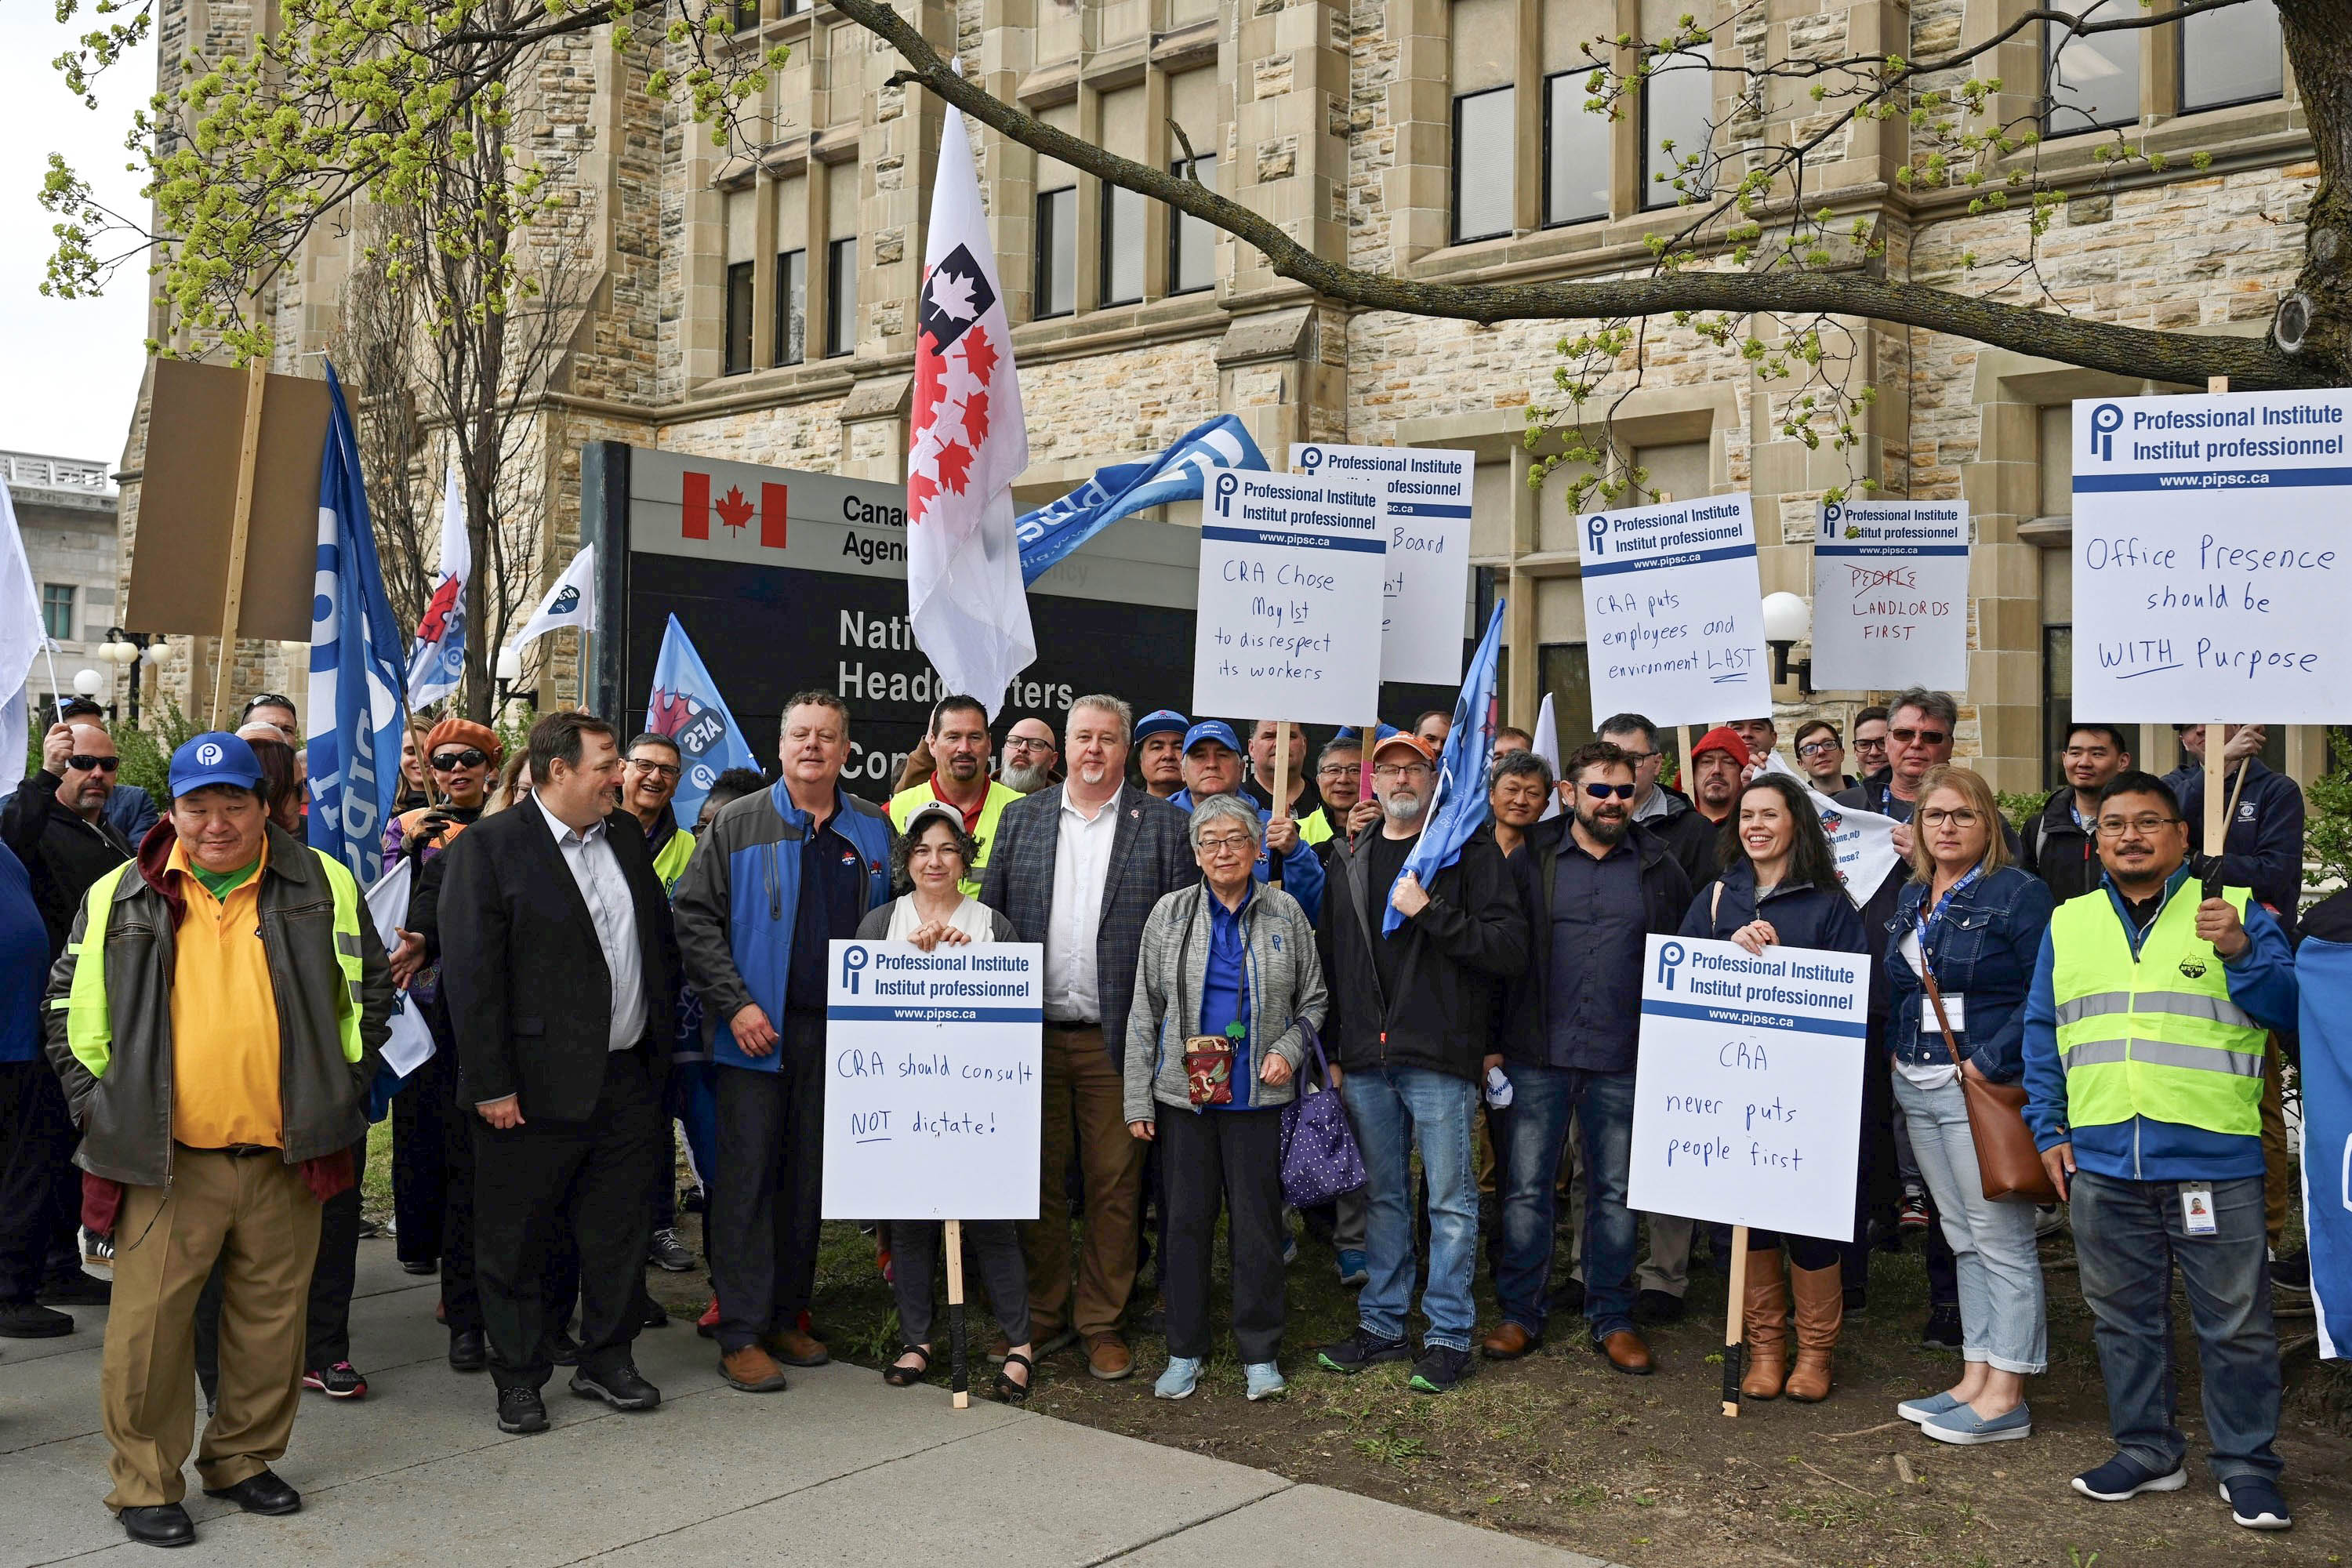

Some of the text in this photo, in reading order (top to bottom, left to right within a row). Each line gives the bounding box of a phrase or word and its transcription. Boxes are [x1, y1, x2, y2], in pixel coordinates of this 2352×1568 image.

[2133, 405, 2343, 430] Professional Institute
[2133, 435, 2343, 462] Institut professionnel
[1328, 455, 1462, 474] Professional Institute
[1387, 480, 1461, 496] ofessionnel
[2159, 473, 2270, 488] www.pipsc.ca
[1243, 482, 1376, 507] Professional Institute
[843, 495, 907, 527] Cana
[1243, 505, 1375, 530] Institut professionnel
[1613, 504, 1740, 532] Professional Institute
[1846, 510, 1958, 521] Professional Institute
[1259, 532, 1330, 546] www.pipsc.ca
[1392, 527, 1445, 554] Board
[1616, 523, 1743, 553] Institut professionnel
[1857, 527, 1958, 540] stitut professionnel
[842, 532, 907, 565] Agen
[1634, 554, 1701, 569] www.pipsc.ca
[1859, 547, 1918, 556] www.pipsc.ca
[2086, 535, 2336, 572] Office Presence
[1223, 560, 1335, 591] CRA Chose
[1596, 589, 1680, 618] CRA puts
[1853, 601, 1950, 616] LANDLORDS
[2147, 582, 2270, 613] should be
[1252, 597, 1309, 628] May 1st
[1214, 627, 1332, 658] to disrespect
[1602, 615, 1735, 651] employees and
[1864, 625, 1916, 641] FIRST
[1219, 659, 1323, 681] its workers
[1609, 648, 1756, 679] environment LAST
[2099, 637, 2318, 679] WITH Purpose
[1839, 851, 1860, 863] lose?
[876, 953, 1029, 972] Professional Institute
[1691, 952, 1854, 984] Professional Institute
[875, 979, 1029, 999] Institut professionnel
[1690, 977, 1853, 1011] Institut professionnel
[895, 1008, 976, 1021] www.pipsc.ca
[1708, 1009, 1794, 1028] www.pipsc.ca
[837, 1048, 1033, 1084] CRA should consult
[1719, 1041, 1768, 1071] CRA
[852, 1110, 996, 1134] NOT dictate!
[1666, 1094, 1797, 1131] never puts
[1667, 1136, 1803, 1171] people first
